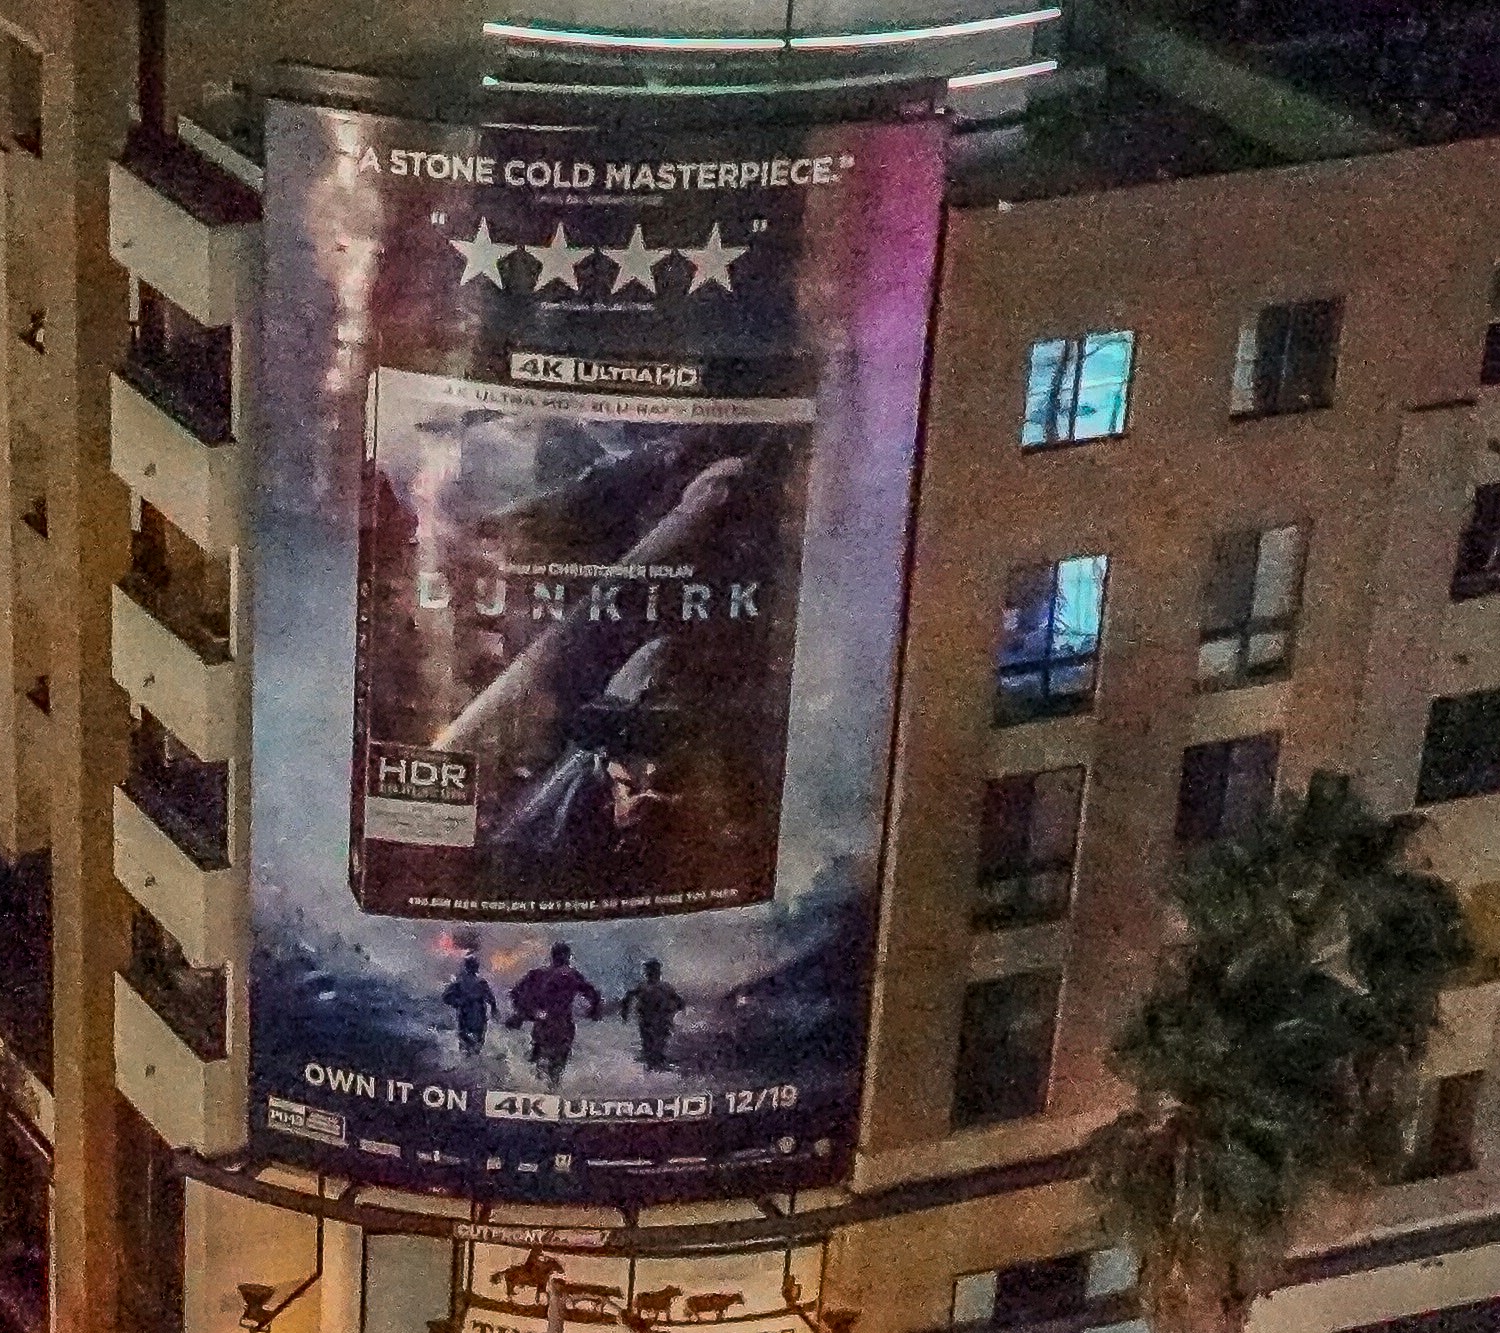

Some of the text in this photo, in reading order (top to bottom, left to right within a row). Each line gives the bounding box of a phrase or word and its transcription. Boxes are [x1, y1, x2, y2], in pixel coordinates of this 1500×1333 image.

[390, 149, 497, 186] STONE
[504, 159, 597, 189] COLD
[517, 358, 564, 381] 4K
[417, 570, 760, 623] DUNKIRK
[379, 756, 468, 789] HDR
[304, 1062, 377, 1100] OWN
[387, 1079, 414, 1103] IT
[422, 1085, 469, 1112] ON
[492, 1095, 549, 1118] 4K
[724, 1084, 799, 1114] 12/19
